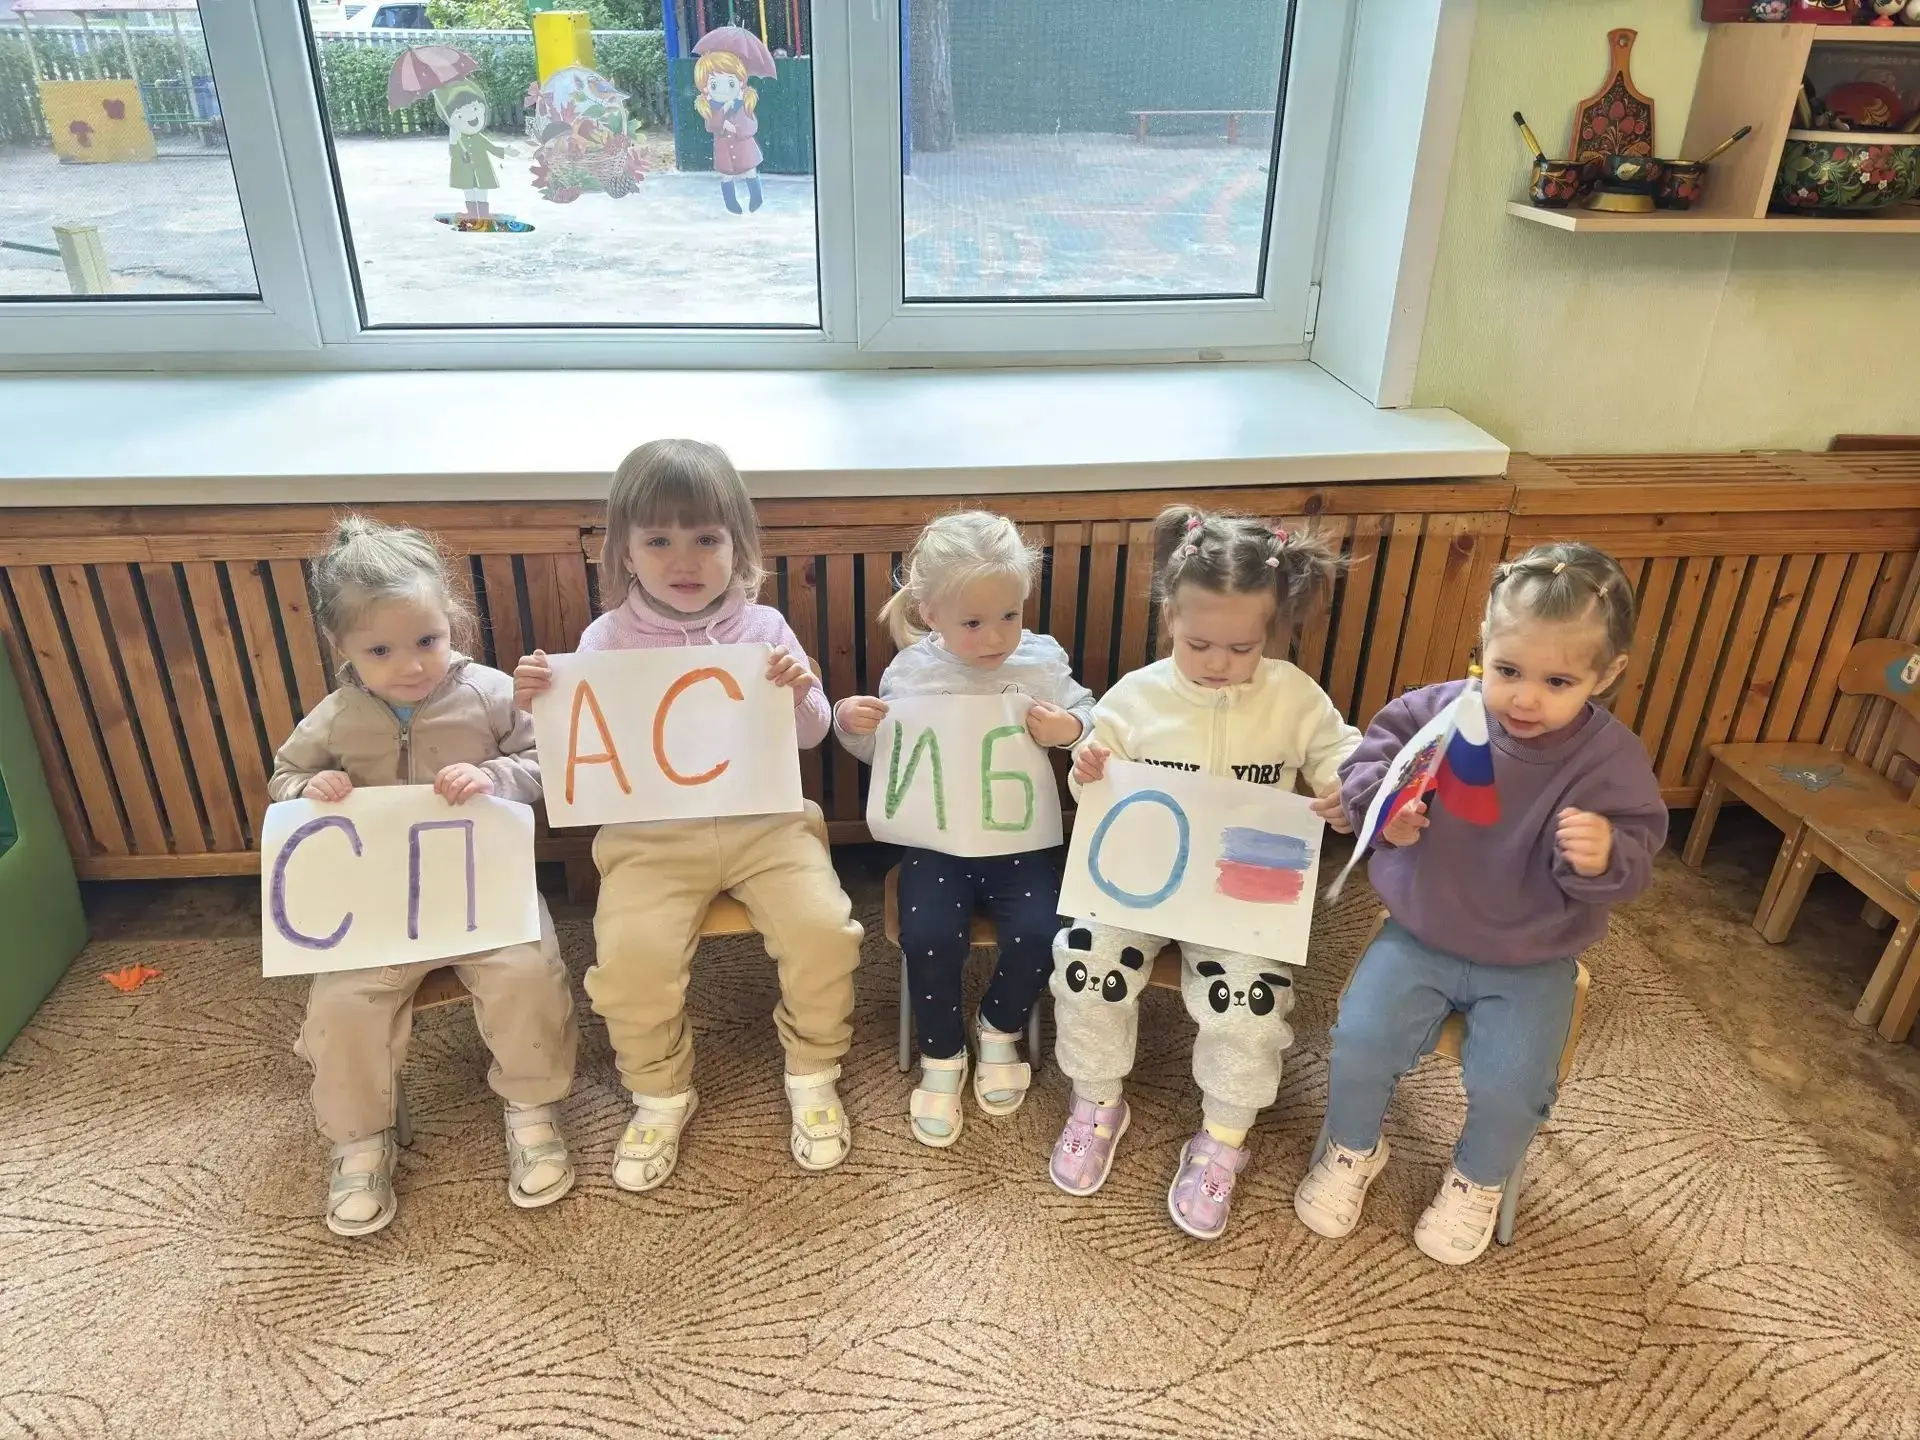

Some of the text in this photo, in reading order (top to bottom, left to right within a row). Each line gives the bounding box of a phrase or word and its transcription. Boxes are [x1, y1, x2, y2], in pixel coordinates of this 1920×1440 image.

[566, 666, 744, 805] АС
[885, 720, 1034, 832] ИБ
[270, 815, 478, 950] СП
